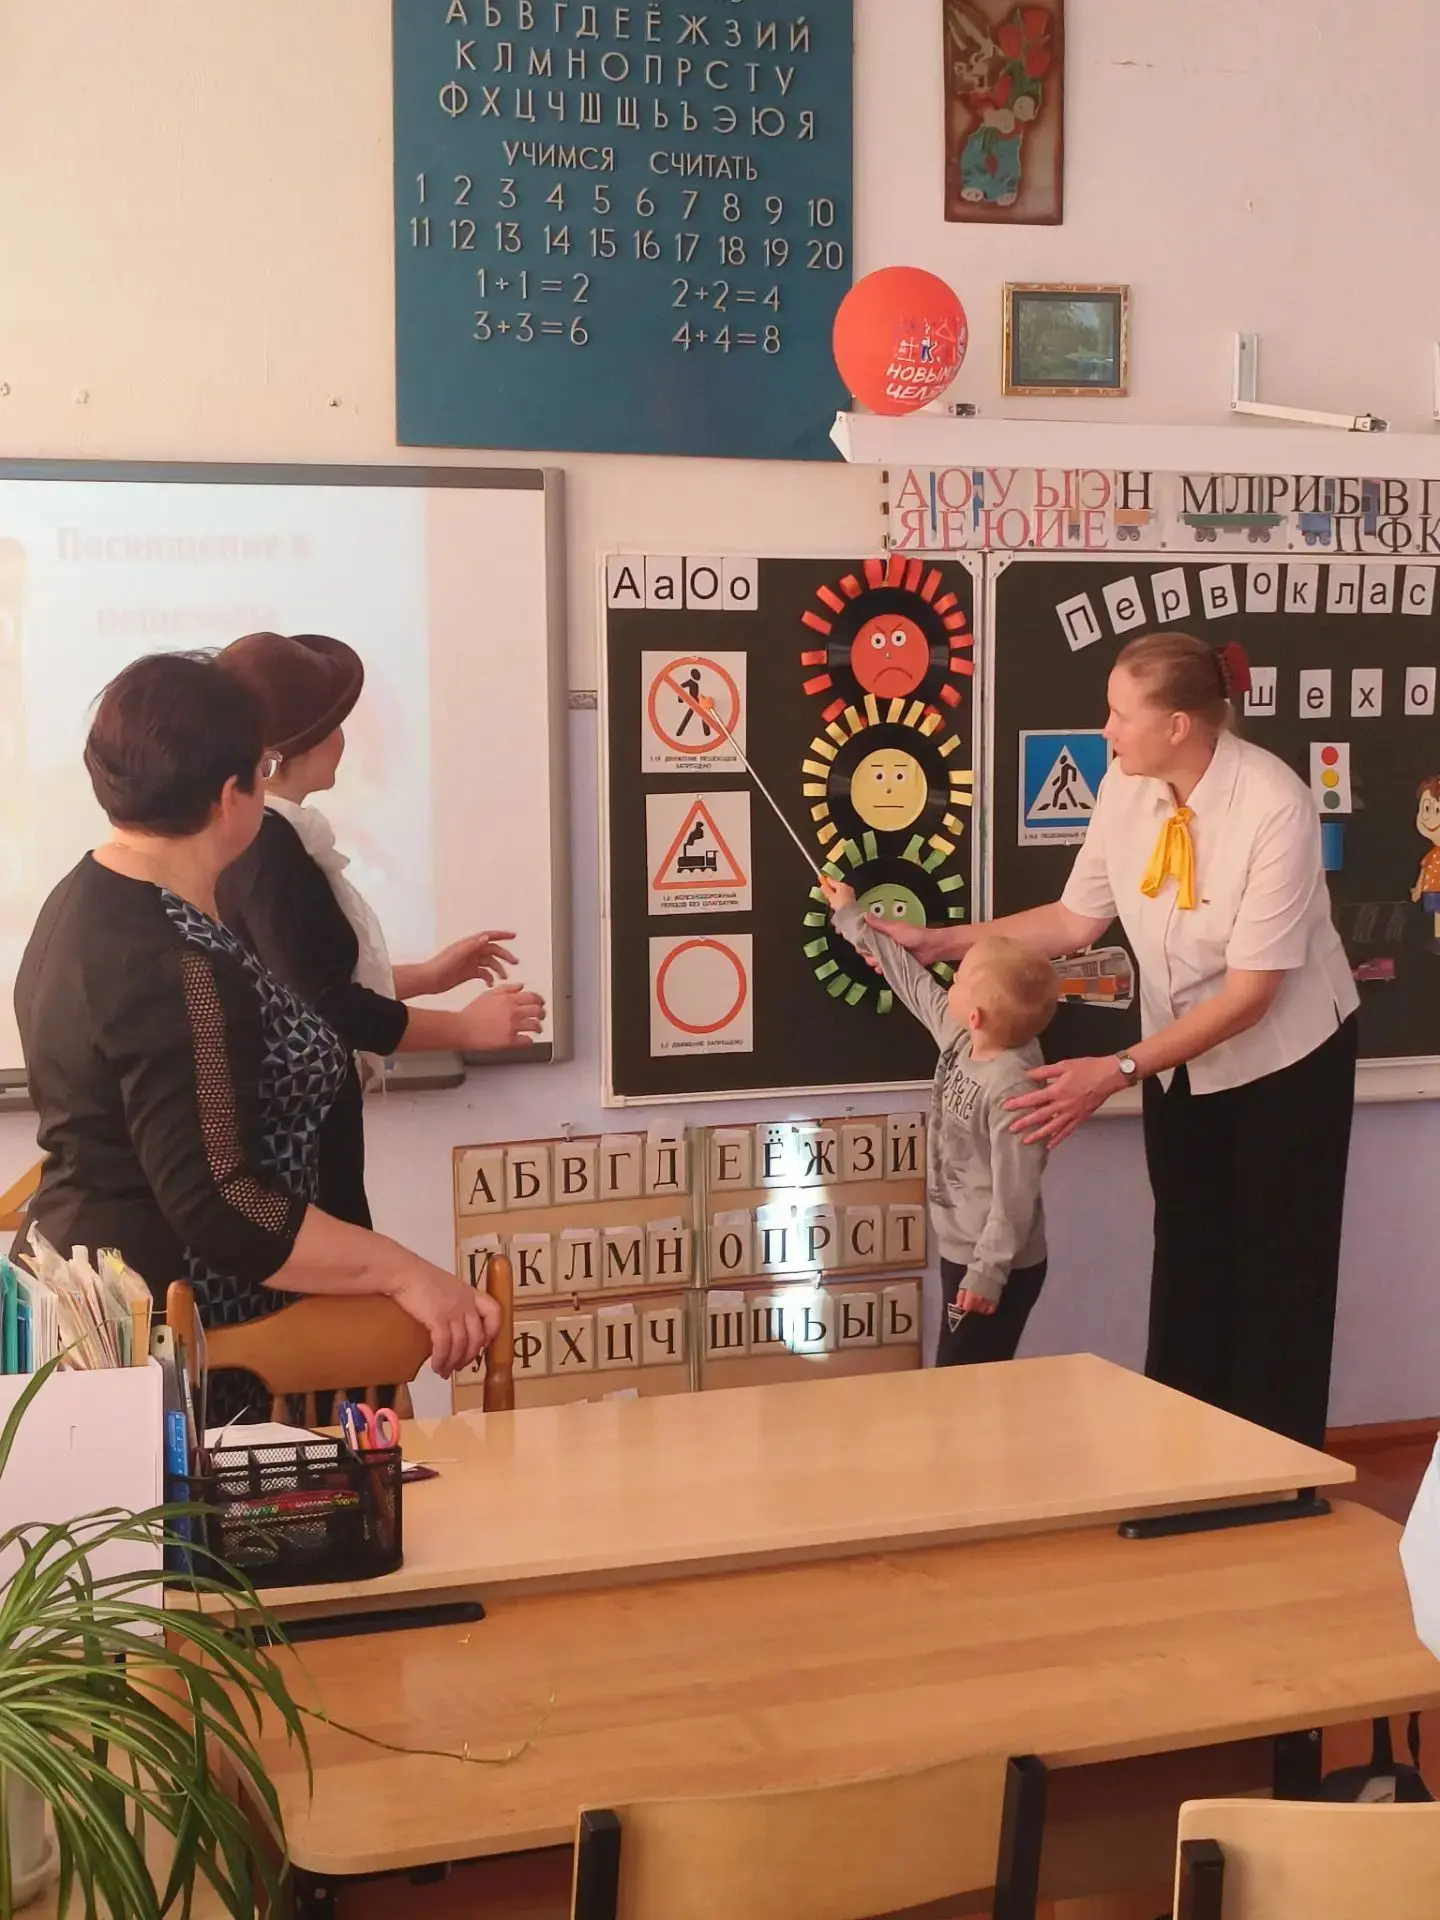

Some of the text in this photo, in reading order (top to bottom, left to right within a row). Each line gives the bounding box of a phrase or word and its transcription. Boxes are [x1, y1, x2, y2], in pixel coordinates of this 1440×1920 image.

[502, 140, 758, 181] УЧИМСЯ СЧИТАТЬ
[415, 172, 834, 227] 1 2 3 4 5 6 7 8 9 10
[410, 216, 843, 270] 11 12 13 14 15 16 17 18 19 20
